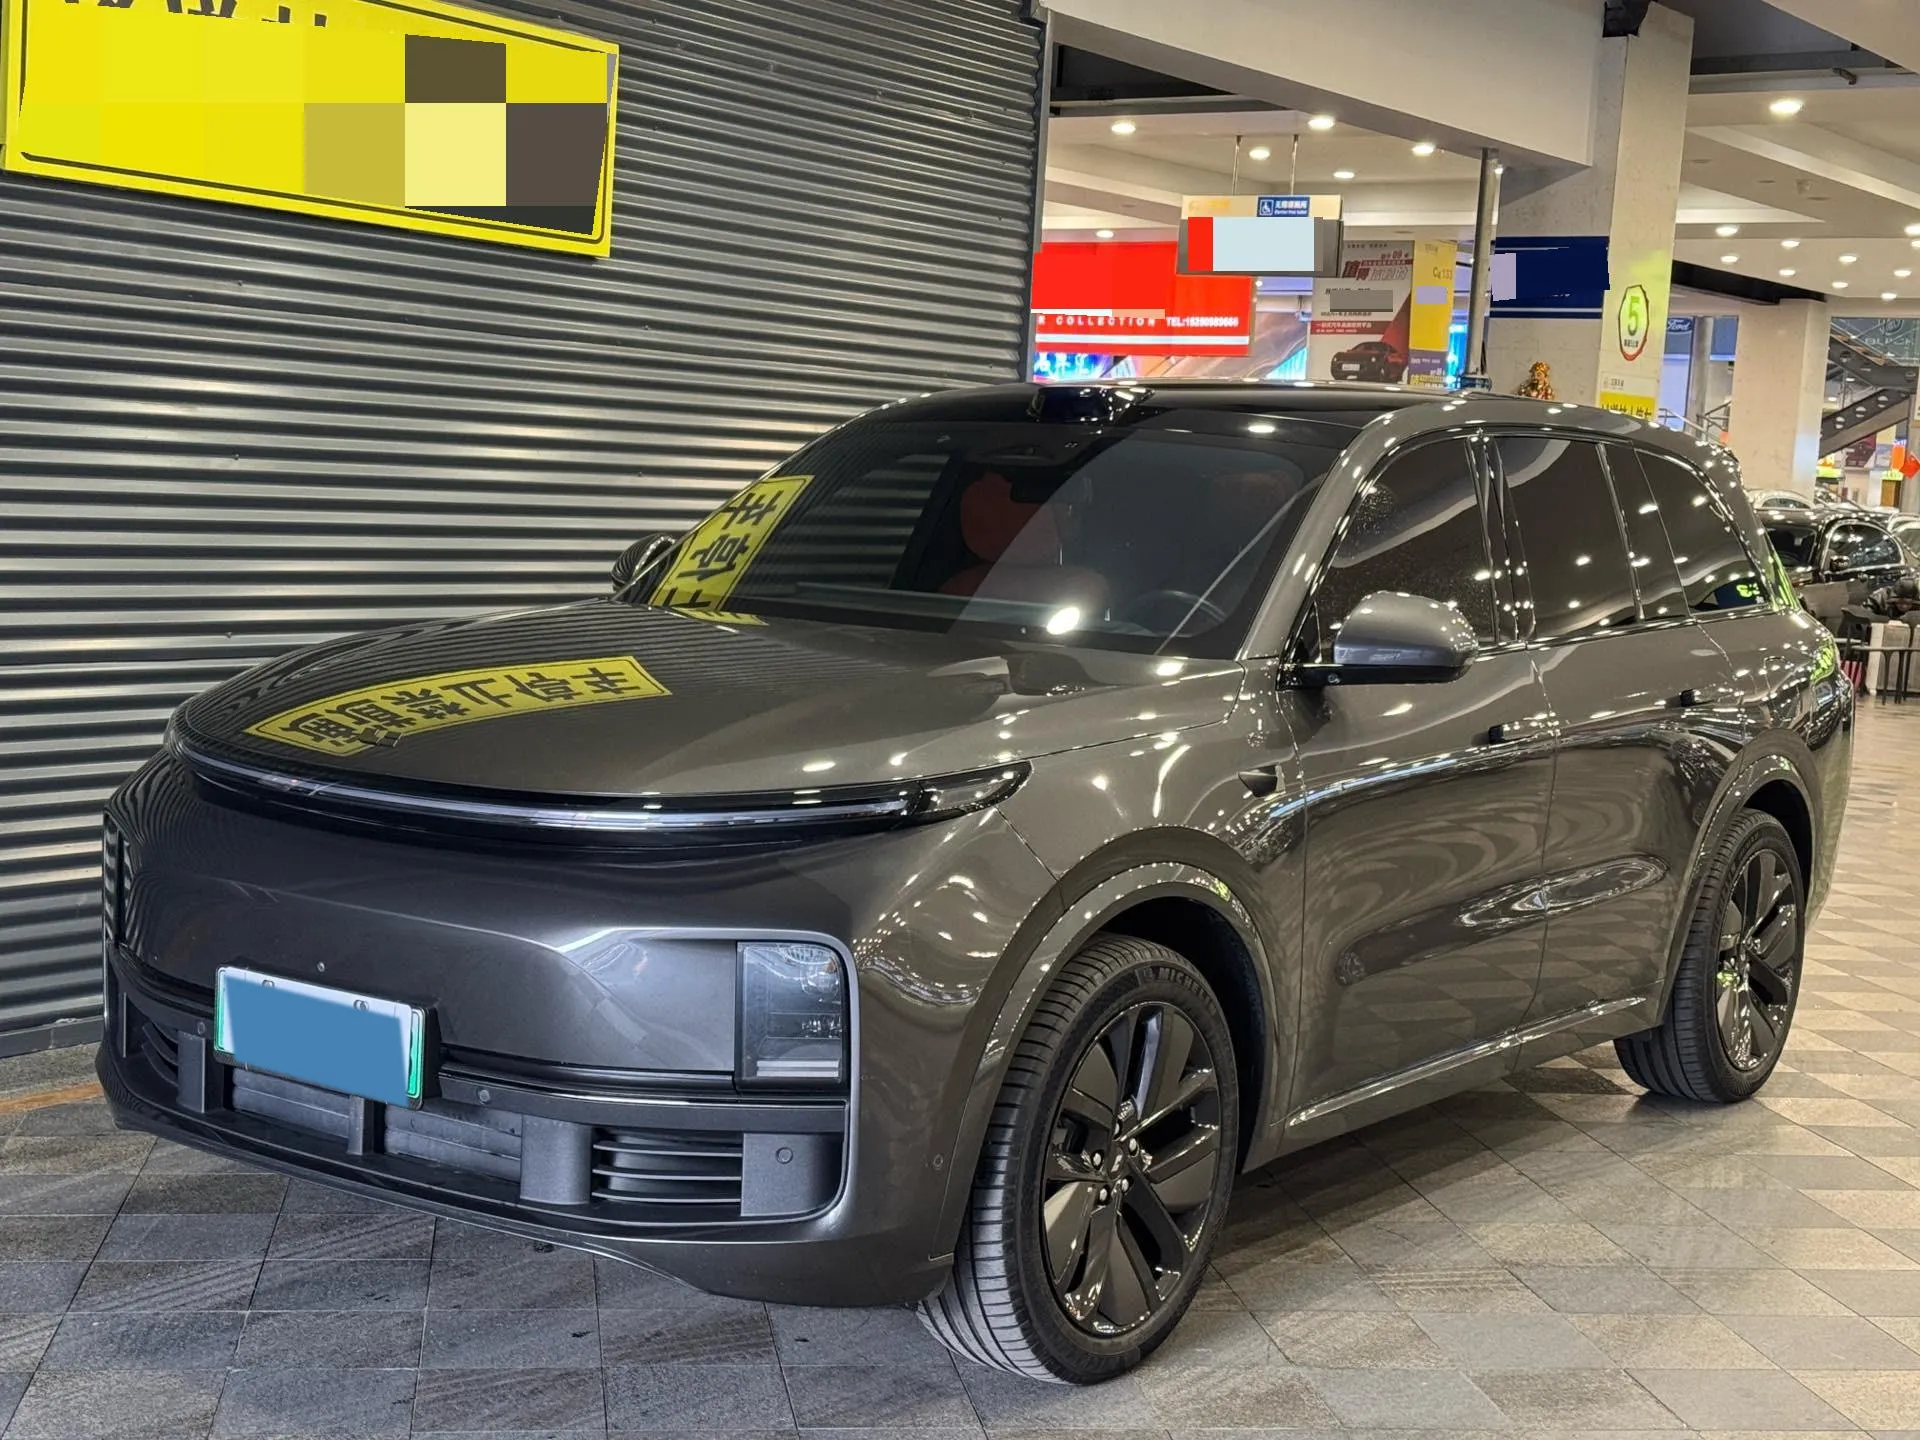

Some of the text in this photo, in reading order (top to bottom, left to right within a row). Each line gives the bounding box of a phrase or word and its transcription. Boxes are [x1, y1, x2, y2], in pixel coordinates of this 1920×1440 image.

[1056, 316, 1156, 328] COLLECTION
[1627, 295, 1641, 337] 5
[1667, 319, 1690, 331] Ford
[1159, 967, 1218, 1014] MICHELIN
